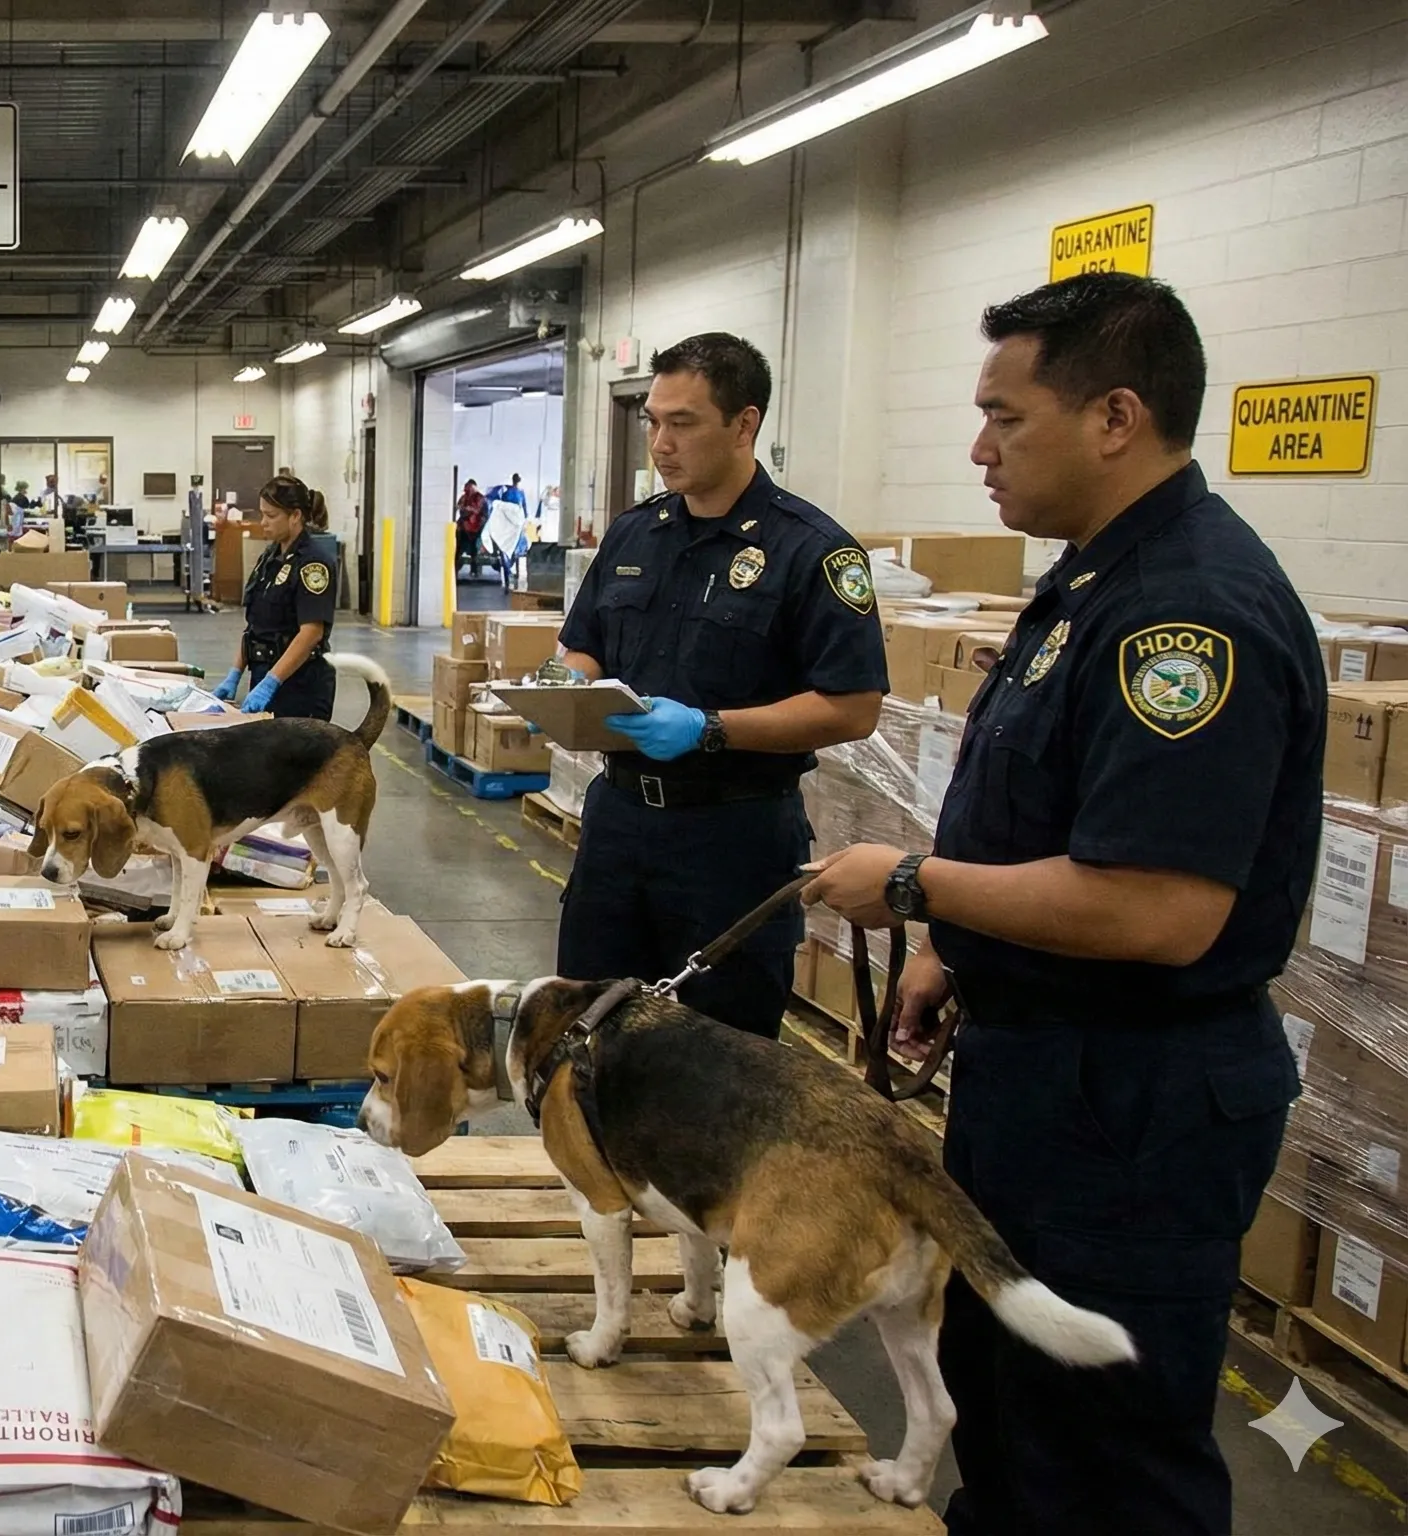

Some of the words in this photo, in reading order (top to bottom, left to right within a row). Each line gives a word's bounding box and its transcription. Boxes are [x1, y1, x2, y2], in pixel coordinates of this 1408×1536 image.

[1055, 217, 1147, 261] QUARANTINE
[1238, 391, 1366, 427] QUARANTINE
[1268, 433, 1323, 460] AREA
[1135, 632, 1214, 658] HDOA
